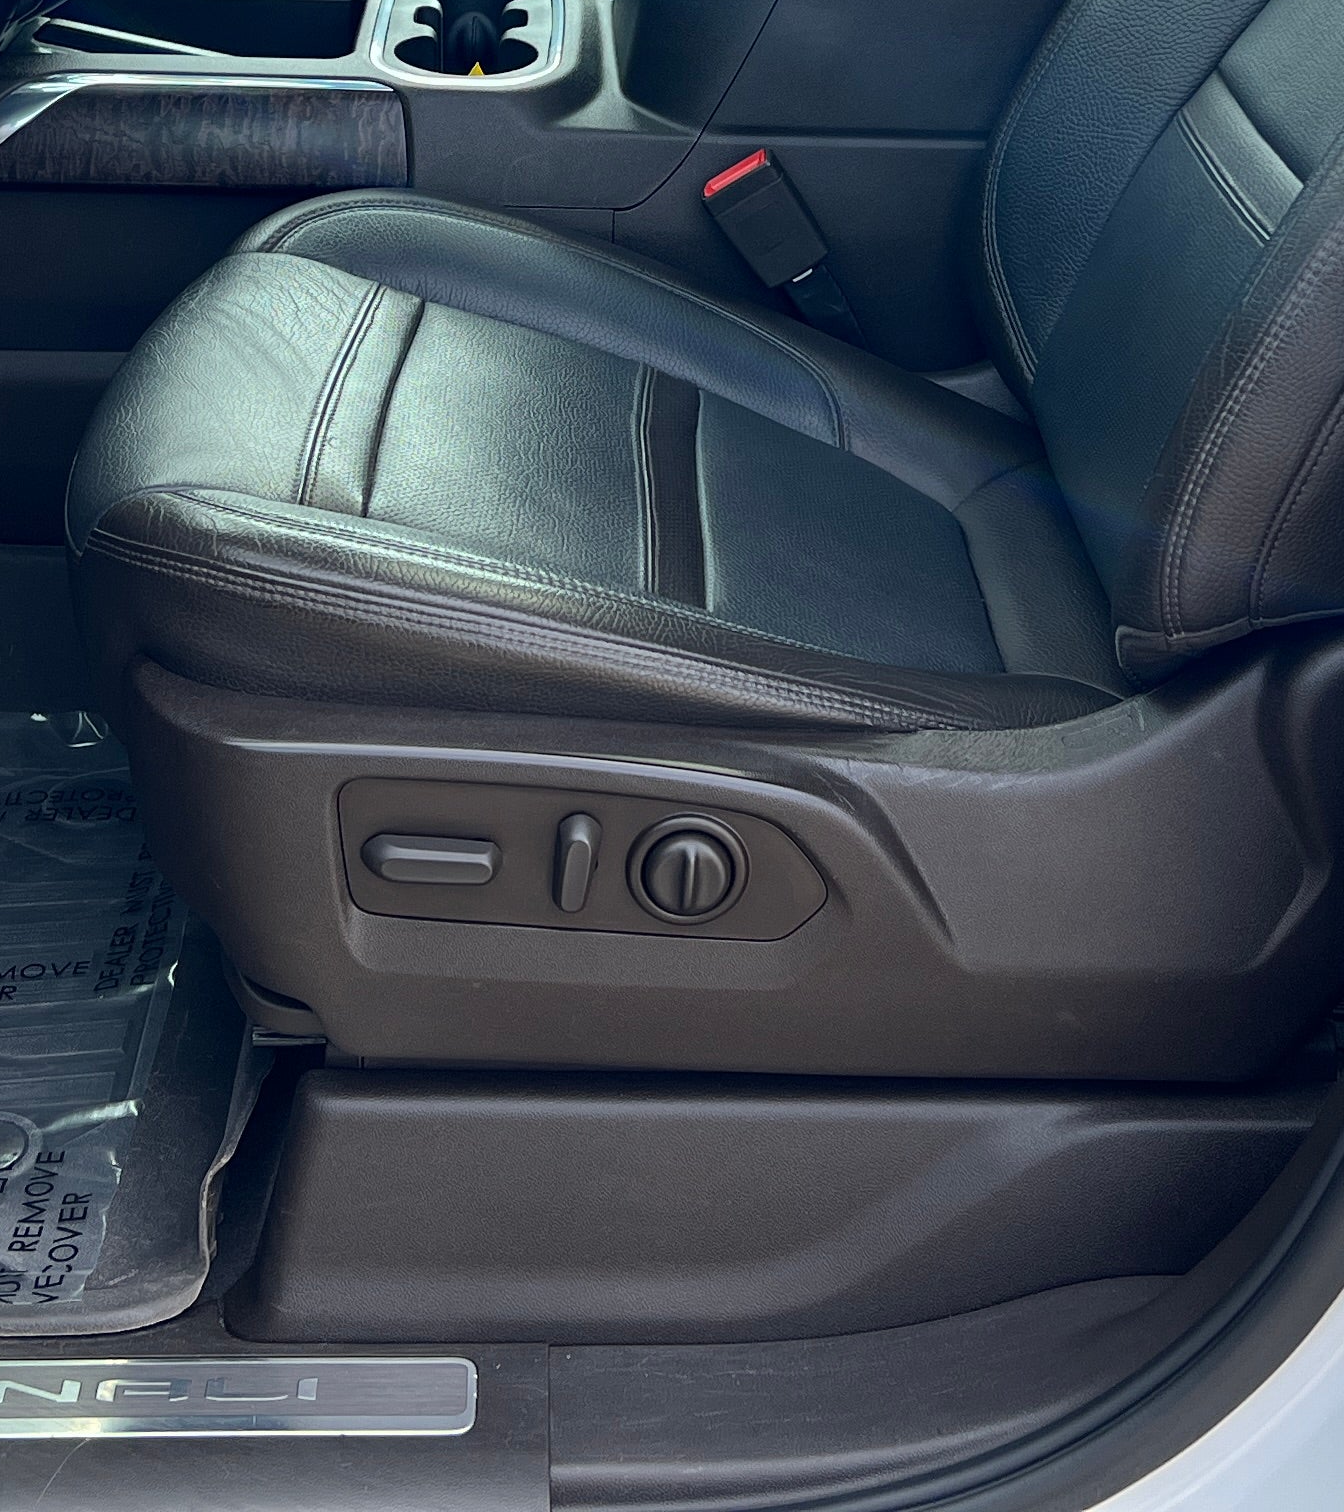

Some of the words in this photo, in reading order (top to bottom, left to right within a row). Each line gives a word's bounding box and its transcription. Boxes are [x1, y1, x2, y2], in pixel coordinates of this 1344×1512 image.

[25, 805, 137, 823] DEALER
[93, 922, 140, 991] DEALER
[120, 871, 156, 916] MUST
[8, 1150, 66, 1252] REMOVE
